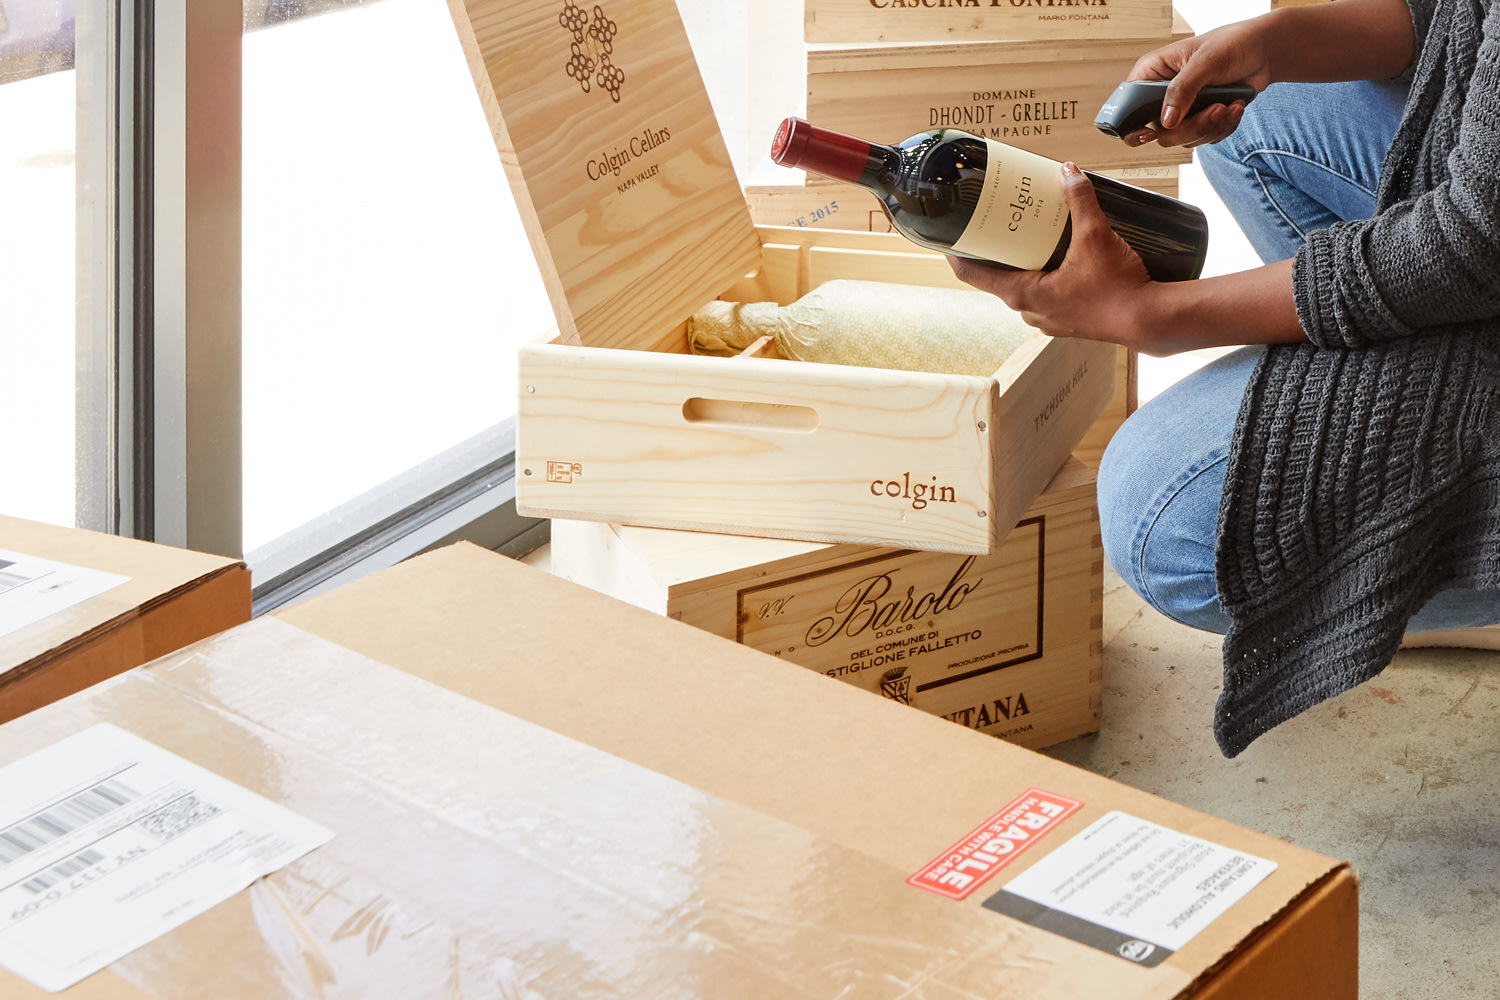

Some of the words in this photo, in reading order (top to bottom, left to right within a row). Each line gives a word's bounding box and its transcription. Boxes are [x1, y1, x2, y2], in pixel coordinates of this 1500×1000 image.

[1069, 13, 1110, 21] FONTANA
[973, 89, 1036, 101] DOMAINE
[930, 105, 995, 127] DHONDT
[1013, 101, 1078, 122] GRELLET
[967, 125, 1052, 139] AMPAGNE
[586, 147, 630, 181] Colgin
[630, 127, 671, 157] Cellars
[617, 178, 637, 195] NAPA
[636, 163, 659, 183] VALLEY
[809, 201, 840, 223] 2015
[1008, 176, 1034, 232] colgin
[1034, 199, 1044, 219] 2014
[1072, 360, 1088, 388] HILL
[870, 471, 957, 510] colgin
[805, 554, 984, 647] Barolo
[851, 648, 873, 661] DEL
[875, 633, 926, 655] COMUNE
[927, 630, 939, 640] DI
[875, 623, 916, 640] D.O.C.G.
[774, 646, 796, 657] NO
[820, 650, 906, 679] STIGLIONE
[908, 629, 982, 657] FALLETTO
[940, 692, 1030, 730] TANA
[993, 723, 1033, 739] NTANA
[988, 796, 1039, 833] HANDLE
[938, 800, 1065, 889] FRAGILE
[959, 831, 995, 856] WITH
[924, 853, 962, 881] CARE
